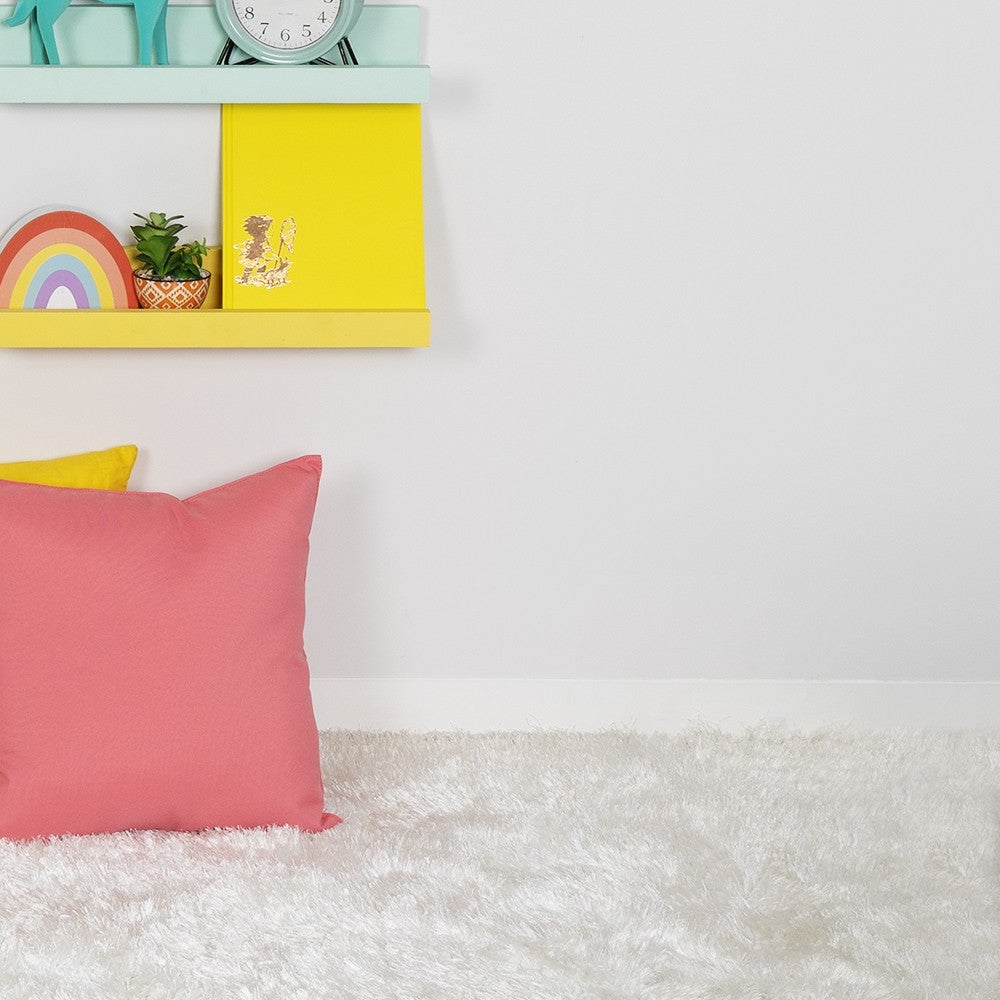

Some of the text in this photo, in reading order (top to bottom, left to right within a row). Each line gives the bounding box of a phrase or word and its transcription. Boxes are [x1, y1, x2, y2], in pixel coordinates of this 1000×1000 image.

[244, 7, 255, 20] 8
[317, 11, 327, 23] 4
[260, 23, 269, 35] 7
[280, 29, 291, 42] 6
[301, 25, 312, 38] 5
